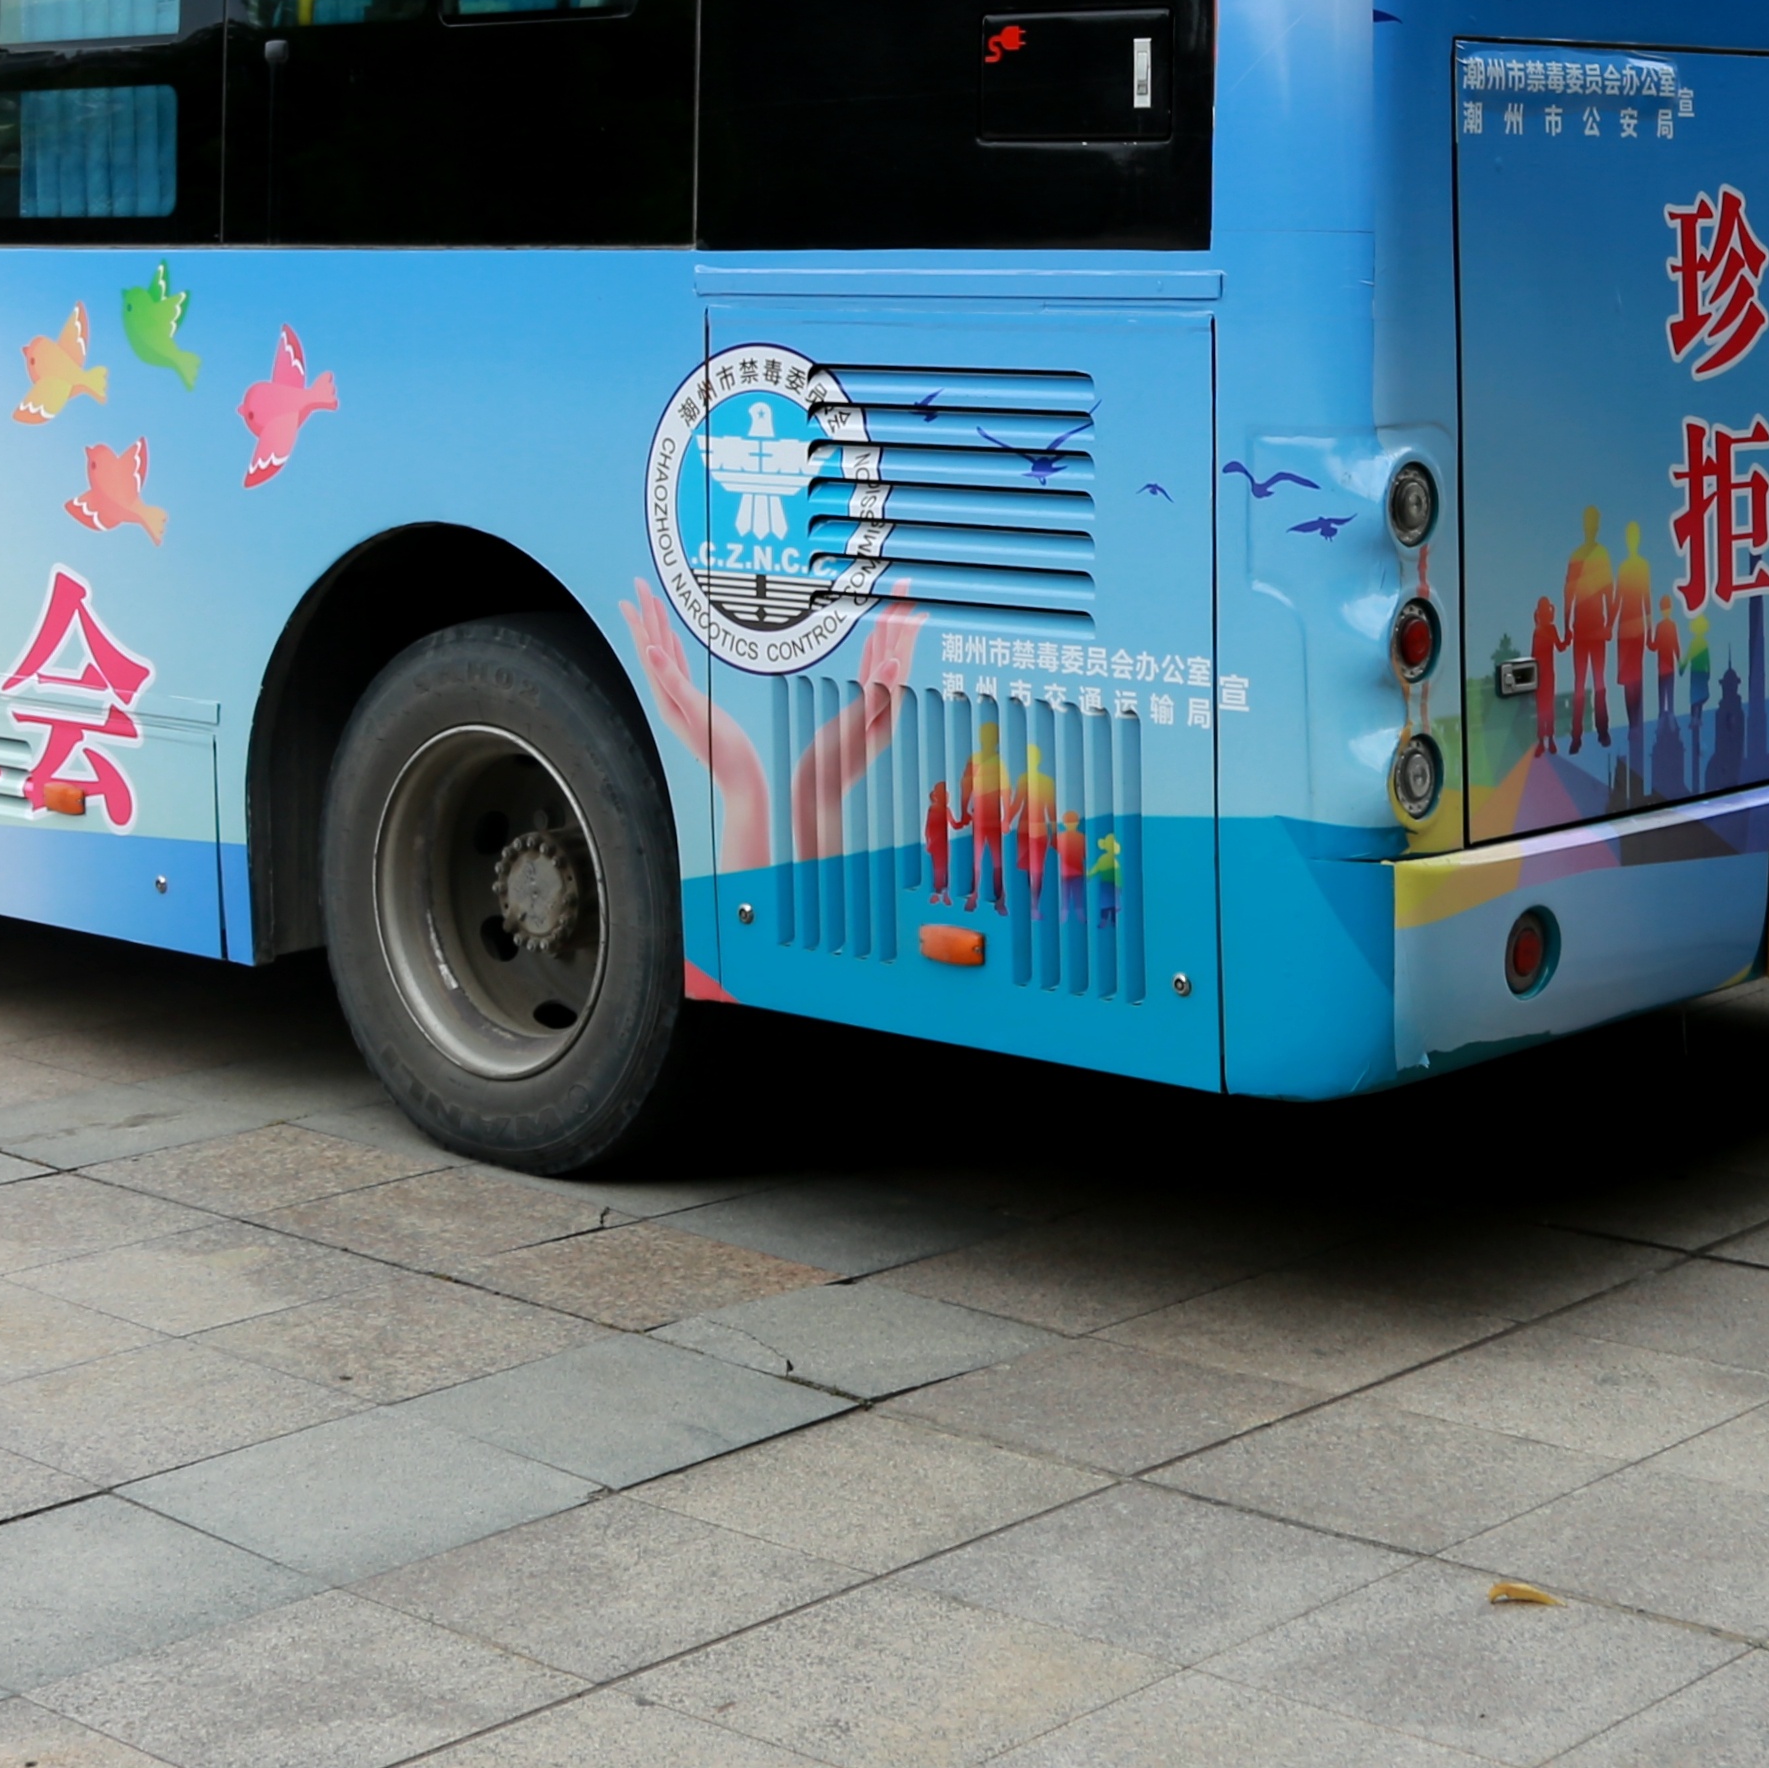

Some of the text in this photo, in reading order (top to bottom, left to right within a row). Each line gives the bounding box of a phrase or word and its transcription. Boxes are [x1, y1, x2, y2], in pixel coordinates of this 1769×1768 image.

[1463, 57, 1695, 118] 潮州市禁毒委员会办公室 宣
[1463, 101, 1674, 140] 潮州市公安局
[677, 356, 852, 435] 潮州市禁毒委员会
[654, 437, 677, 567] CHAOZHOU
[671, 572, 759, 661] NARCOTICS
[767, 609, 847, 662] CONTROL
[941, 633, 1250, 712] 潮州市禁毒委员会办公室 宣
[941, 672, 1212, 730] 潮州市交通运输局
